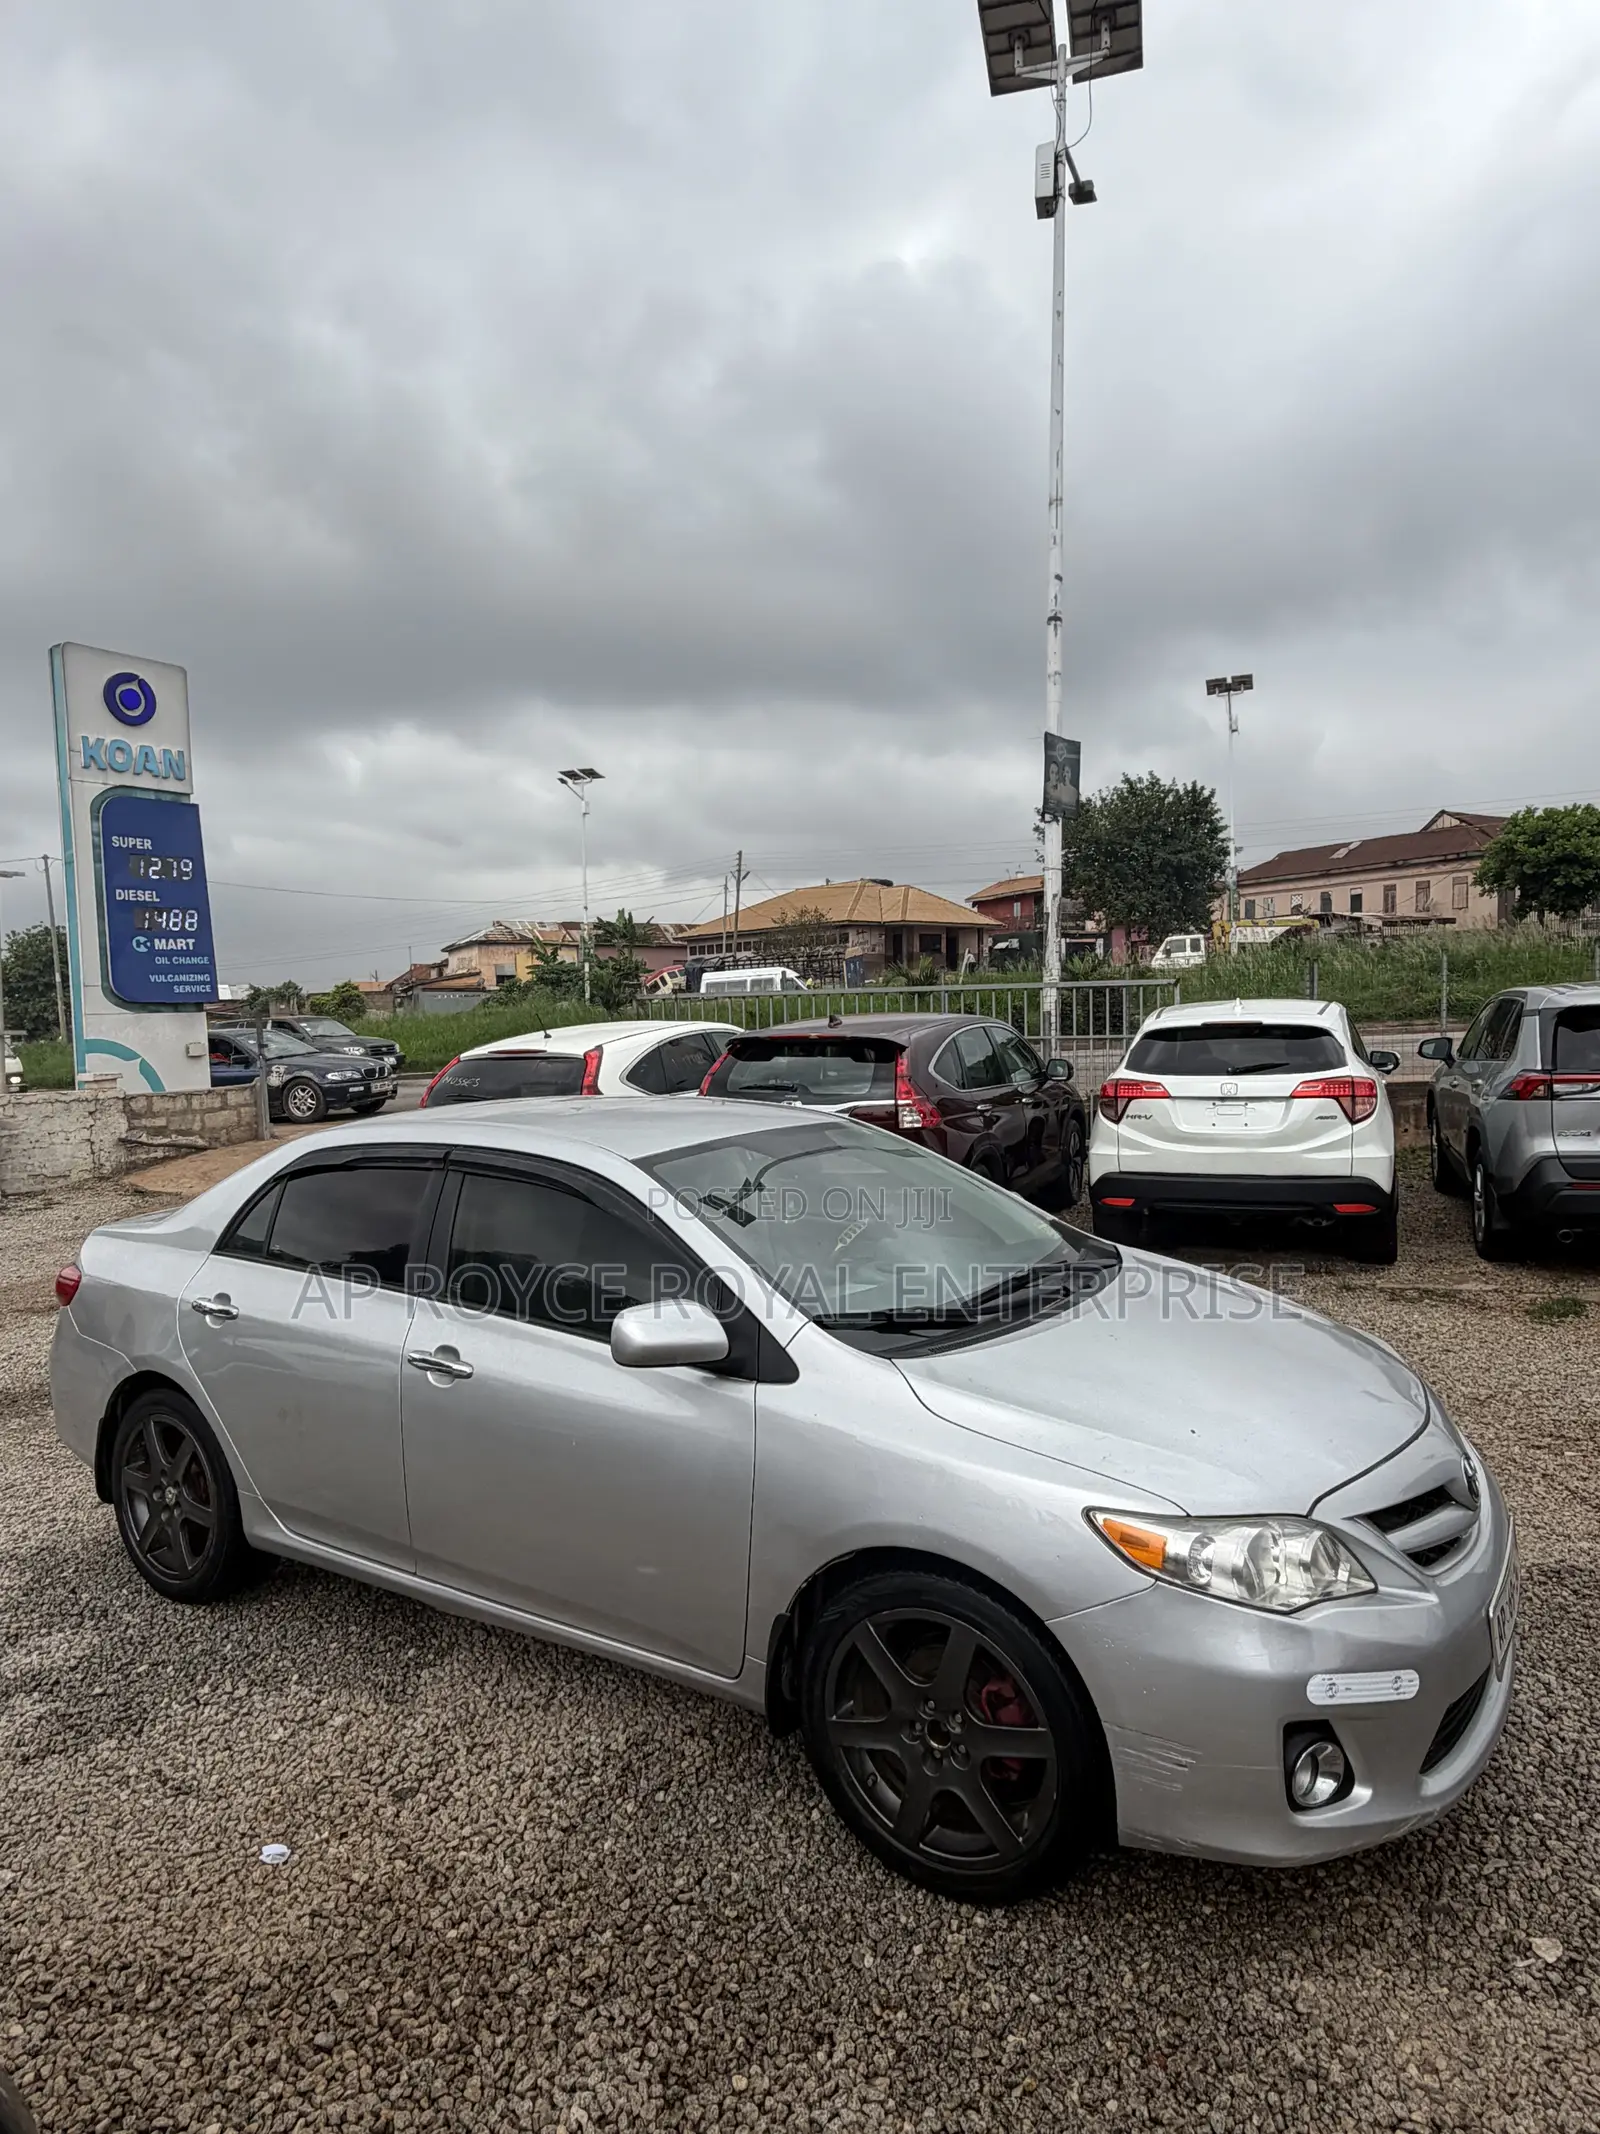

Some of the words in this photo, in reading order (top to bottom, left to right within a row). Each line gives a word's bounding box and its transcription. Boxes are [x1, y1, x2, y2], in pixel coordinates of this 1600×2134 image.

[81, 735, 186, 781] KOAN
[112, 836, 152, 850] SUPER
[115, 889, 160, 902] DIESEL
[153, 938, 195, 950] MART
[155, 956, 170, 965] OIL
[172, 956, 209, 965] CHANGE
[149, 974, 210, 982] VULCANIZING
[173, 985, 212, 993] SERVICE
